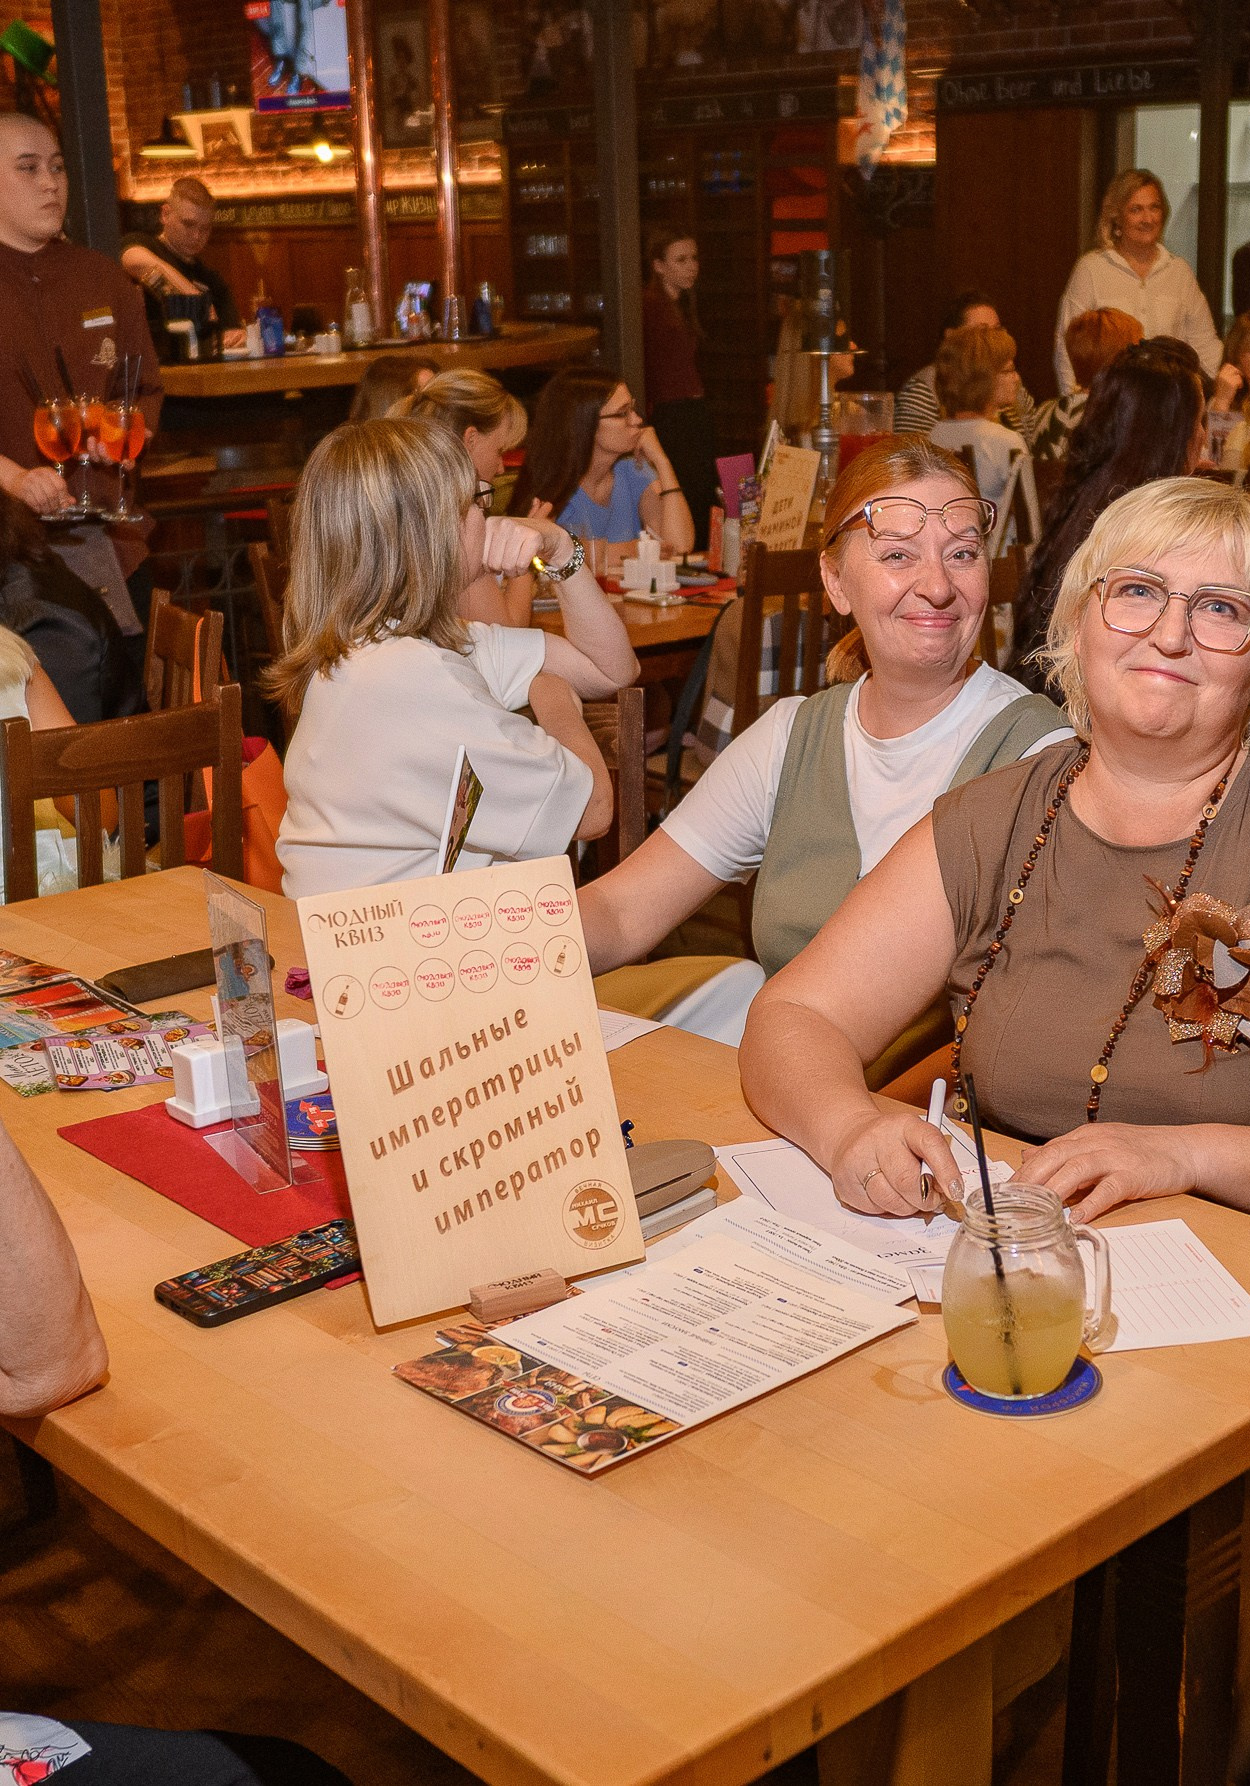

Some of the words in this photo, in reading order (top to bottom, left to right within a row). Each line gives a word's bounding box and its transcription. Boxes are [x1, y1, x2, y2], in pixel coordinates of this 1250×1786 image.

[1093, 66, 1155, 94] Liebe
[307, 899, 405, 935] МОДНЫЙ
[334, 925, 386, 949] КВИЗ
[386, 1008, 529, 1096] Шальные
[369, 1032, 583, 1161] императрицы
[411, 1169, 429, 1193] и
[439, 1076, 585, 1177] скромный
[434, 1127, 602, 1235] император
[574, 1181, 603, 1194] ВЕЧНАЯ
[569, 1201, 619, 1229] МС
[570, 1198, 598, 1209] МИХАИЛ
[583, 1234, 616, 1248] ВИЗИТКА
